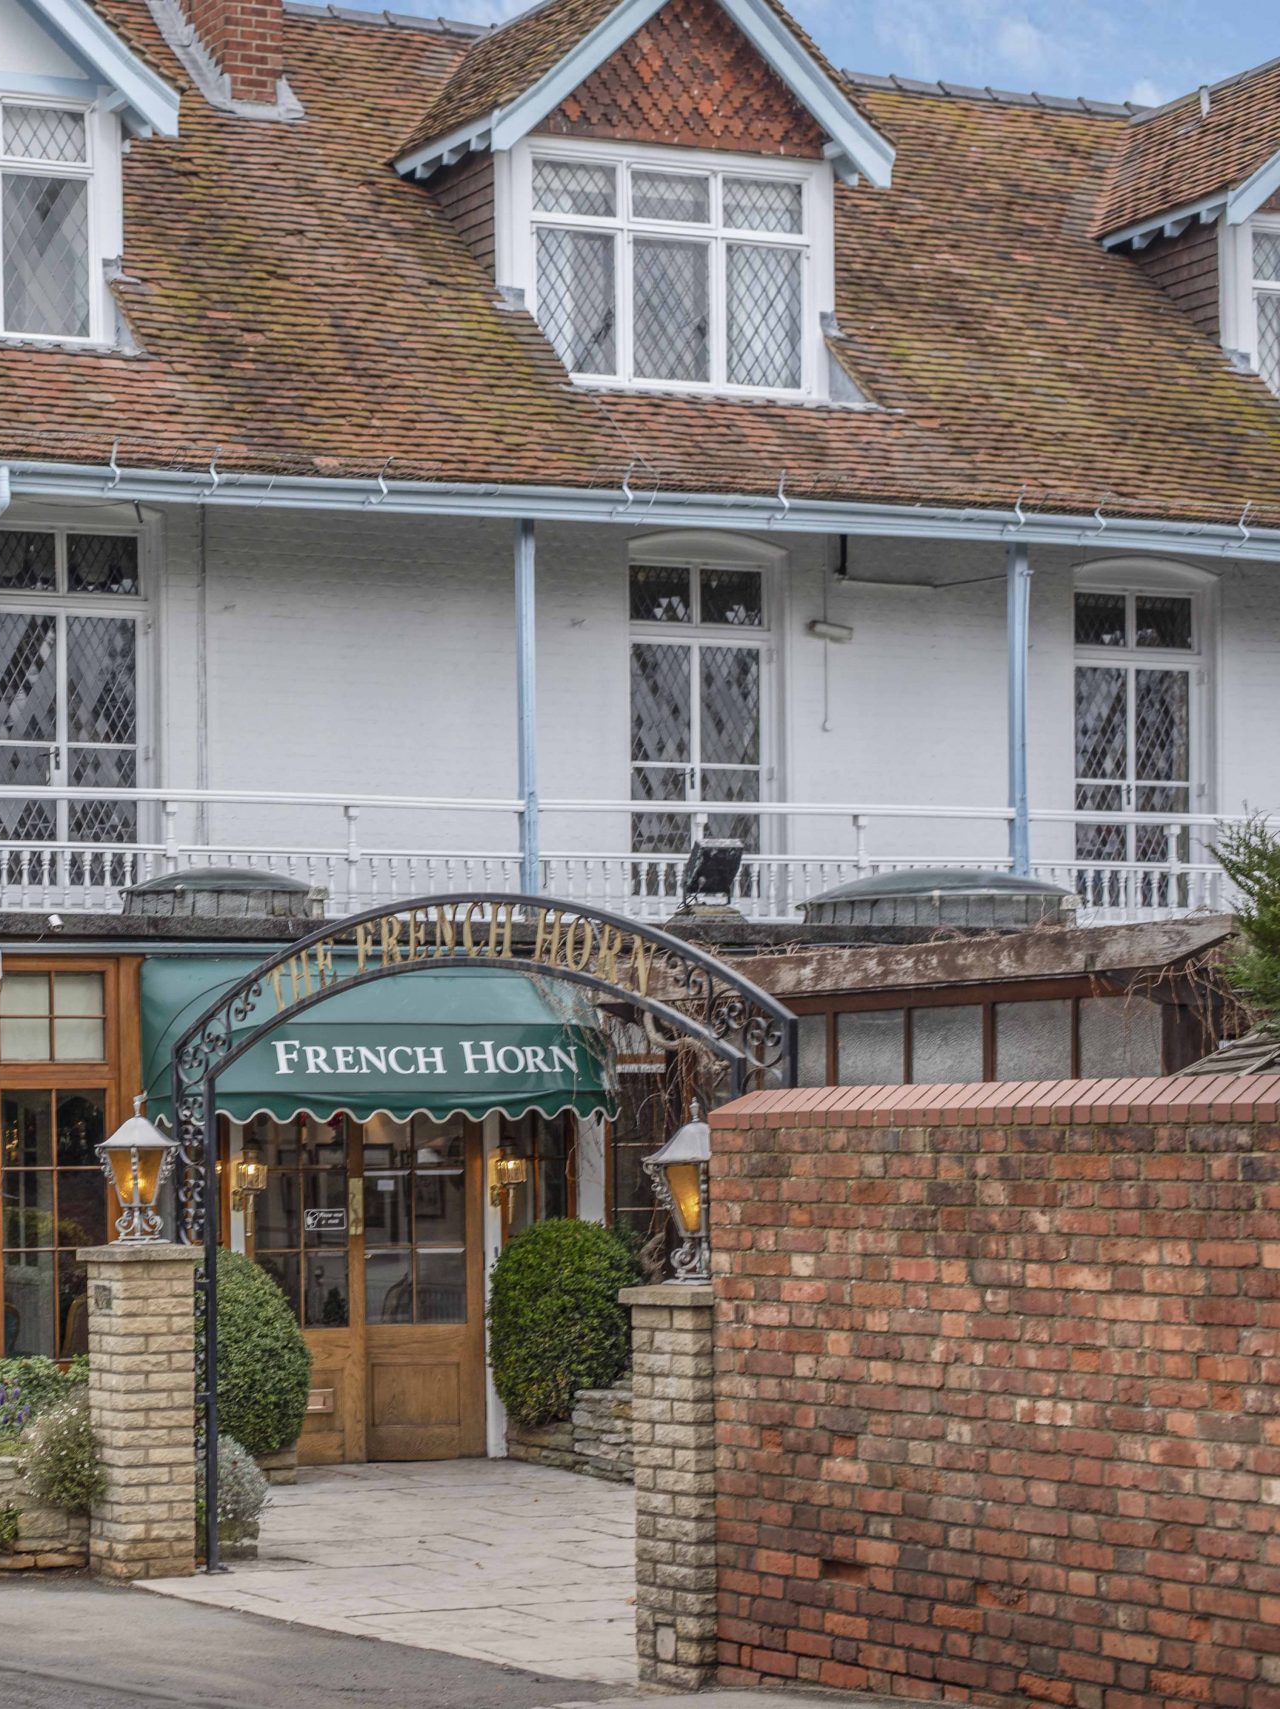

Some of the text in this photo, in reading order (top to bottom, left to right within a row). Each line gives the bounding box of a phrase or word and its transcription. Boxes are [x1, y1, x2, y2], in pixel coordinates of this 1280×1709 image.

[267, 902, 657, 1012] THE FRENCH HORN
[271, 1040, 578, 1075] FRENCH HORN
